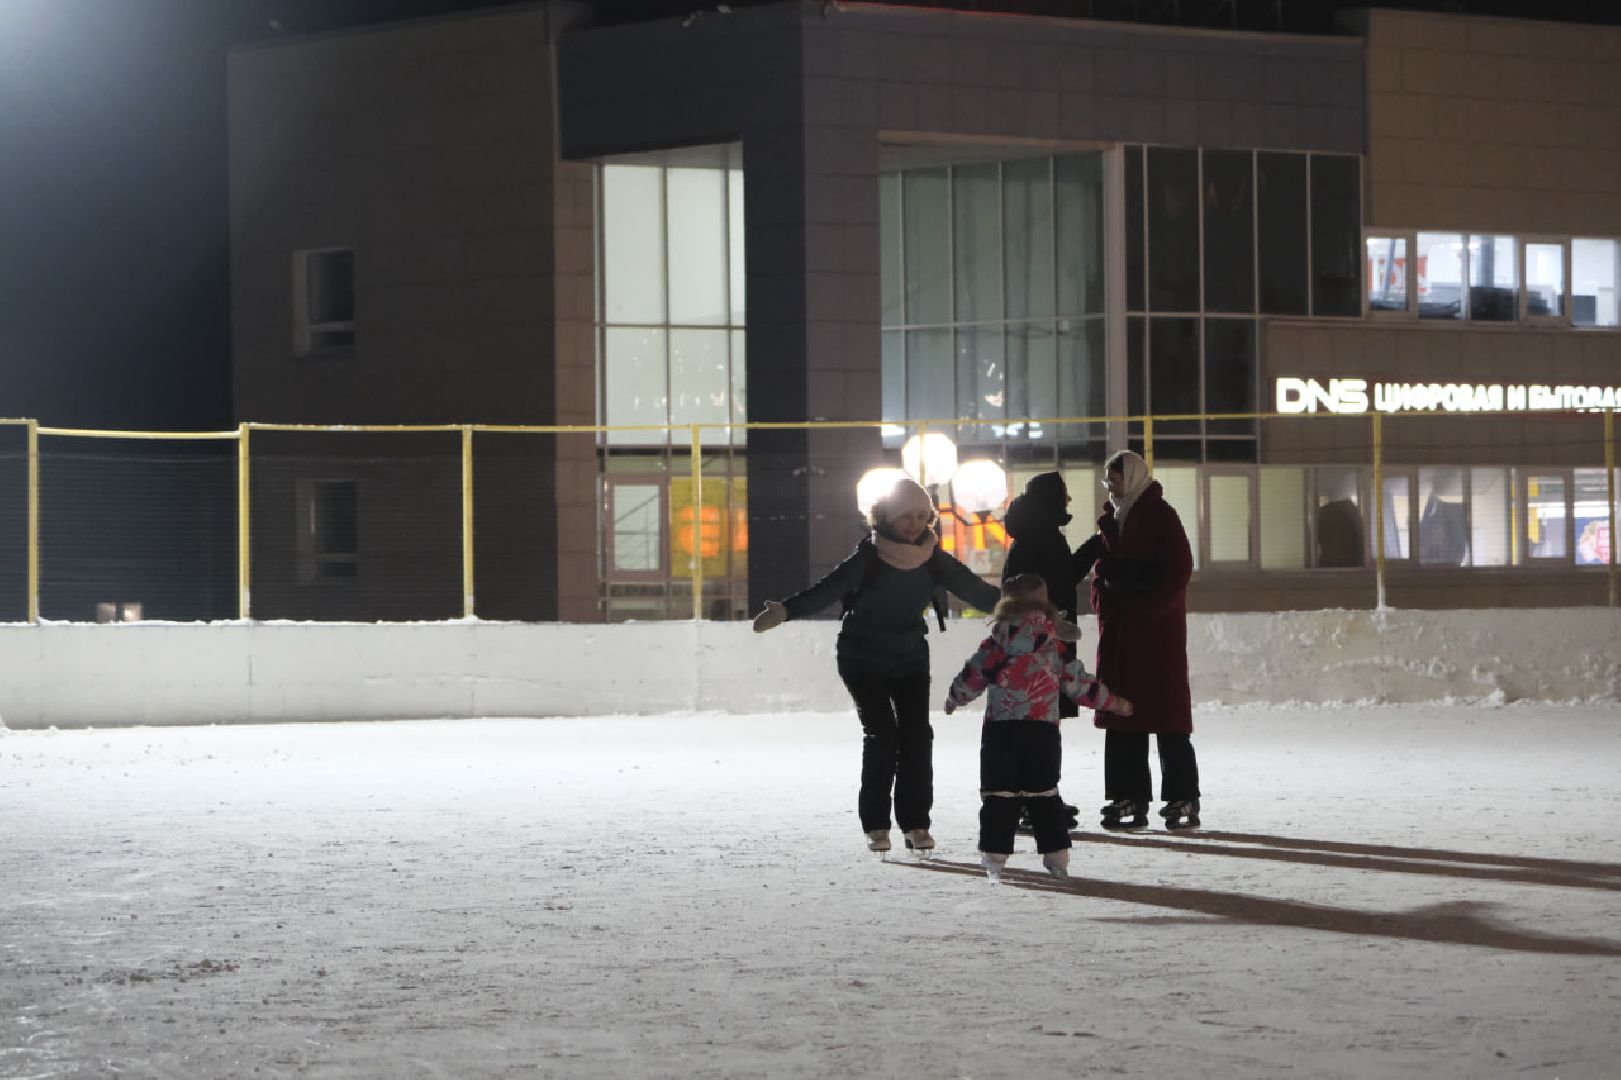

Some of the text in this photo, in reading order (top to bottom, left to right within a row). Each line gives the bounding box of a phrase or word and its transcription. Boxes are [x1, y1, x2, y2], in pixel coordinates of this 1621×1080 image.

[1276, 377, 1369, 414] DNS
[1374, 382, 1504, 412] ЦИФРОВАЯ
[1506, 384, 1527, 411] И
